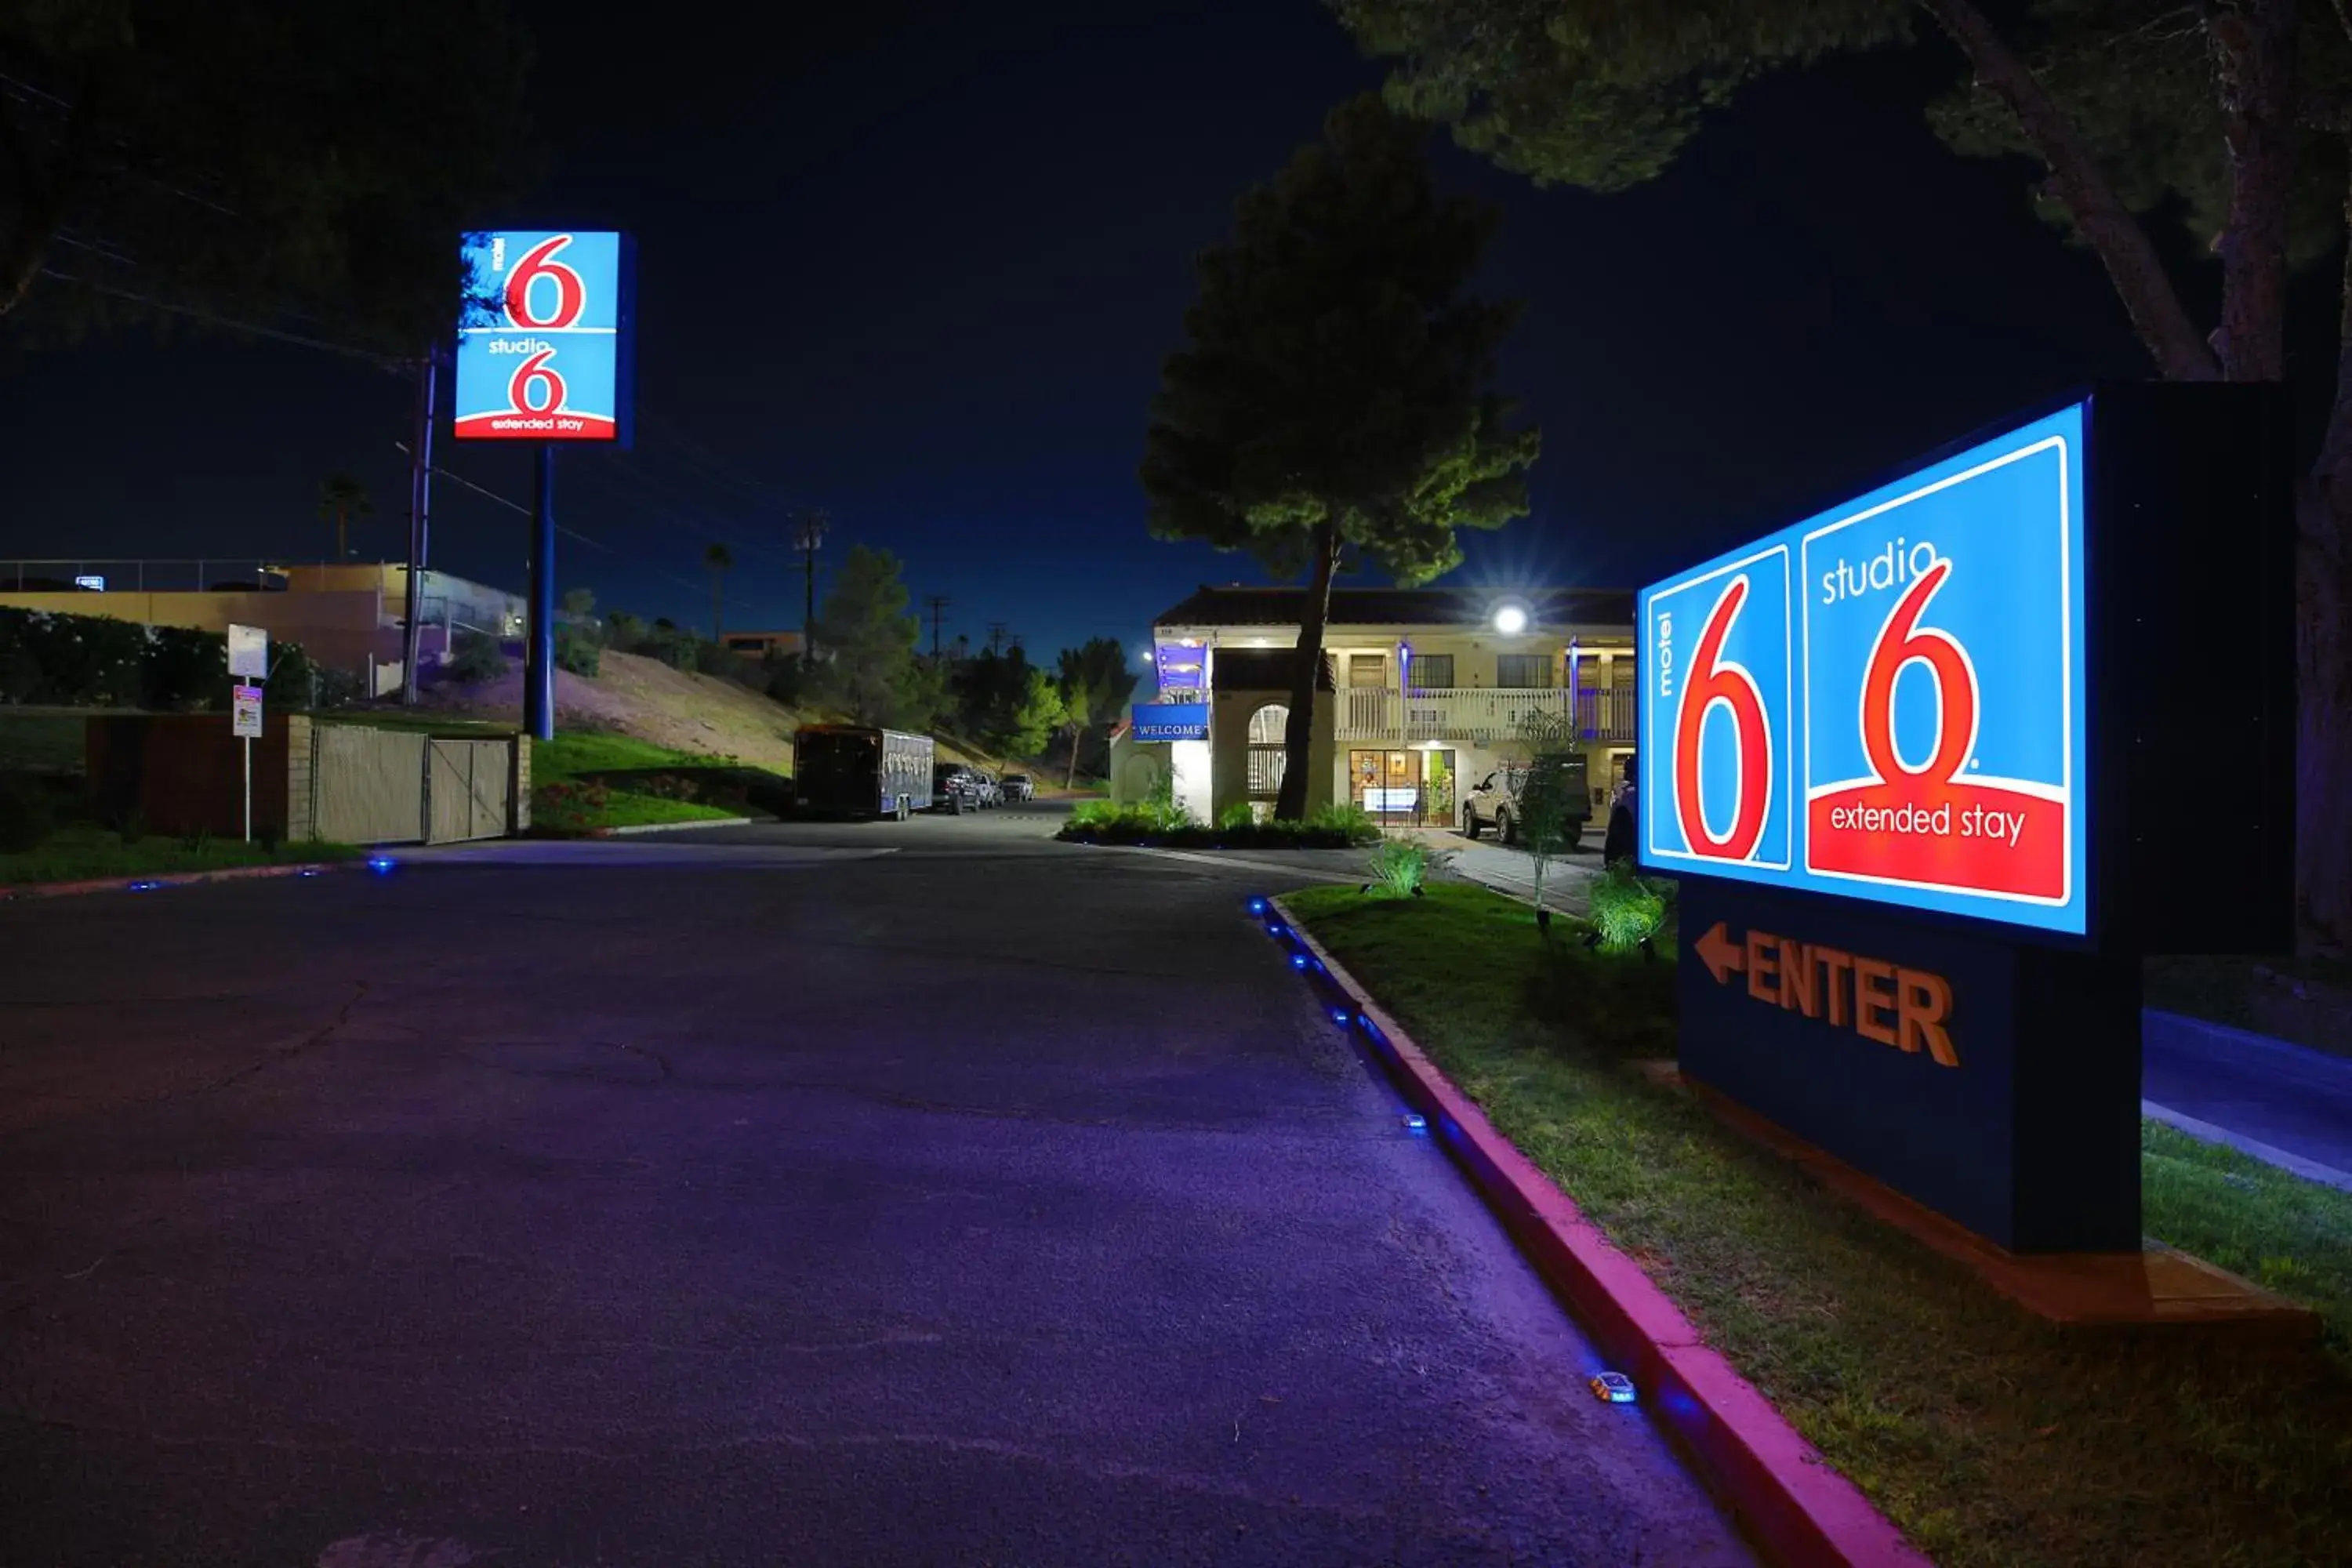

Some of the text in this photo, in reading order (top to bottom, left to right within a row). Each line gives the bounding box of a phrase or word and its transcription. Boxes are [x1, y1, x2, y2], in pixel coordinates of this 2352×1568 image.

[504, 234, 586, 328] 6
[489, 338, 550, 354] studio
[508, 348, 567, 414] 6
[492, 419, 583, 431] extended stay
[1822, 537, 1937, 604] studio
[1658, 612, 1671, 697] motel
[1860, 558, 1980, 784] 6
[1140, 725, 1201, 735] WELCOME
[1672, 574, 1773, 862] 6
[1831, 802, 2027, 846] extended stay
[1747, 930, 1959, 1067] ENTER
